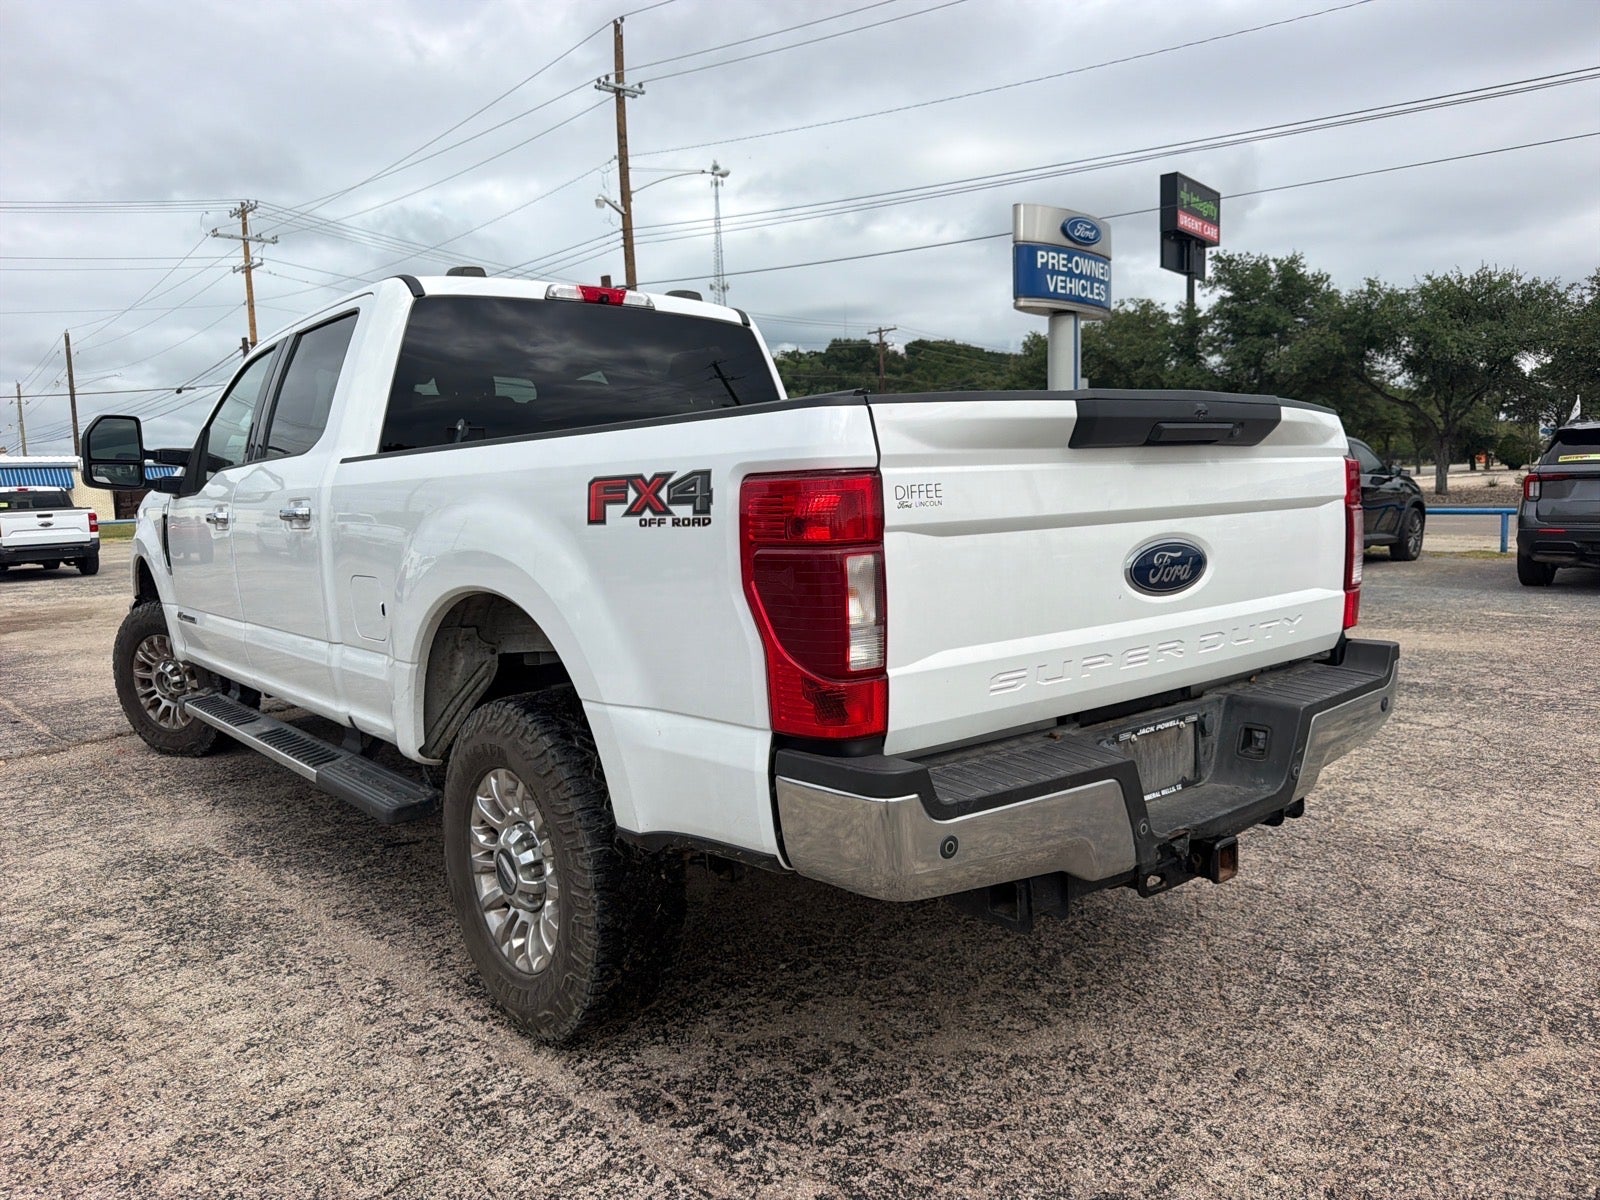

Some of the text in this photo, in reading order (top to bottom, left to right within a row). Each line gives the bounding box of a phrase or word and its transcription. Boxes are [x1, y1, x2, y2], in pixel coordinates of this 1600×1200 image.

[1074, 222, 1096, 240] Ford
[1180, 214, 1218, 239] URGENT CARE
[1036, 251, 1109, 282] PRE-OWNED
[1046, 274, 1106, 302] VEHICLES
[587, 469, 713, 525] FX4
[894, 483, 943, 501] DIFFEE
[915, 500, 943, 508] LINCOLN
[639, 517, 712, 527] OFF ROAD
[1148, 551, 1194, 584] Ford
[988, 614, 1303, 697] SUPER DUTY
[1136, 718, 1180, 736] JACK POWELL
